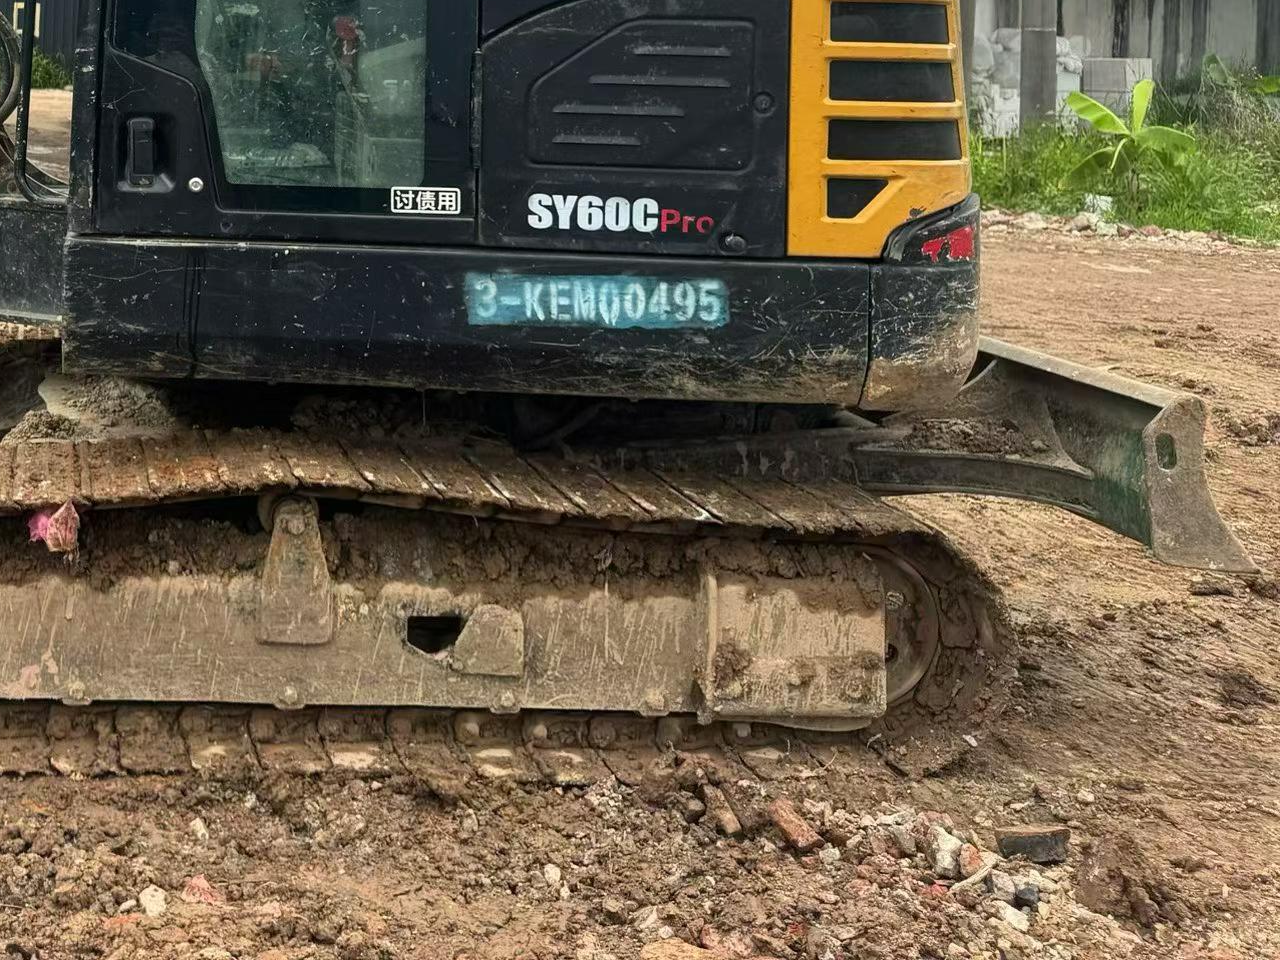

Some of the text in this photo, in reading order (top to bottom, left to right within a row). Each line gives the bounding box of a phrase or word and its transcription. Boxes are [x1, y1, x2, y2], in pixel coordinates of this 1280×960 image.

[394, 190, 458, 211] 讨债用
[527, 193, 659, 232] SY60C
